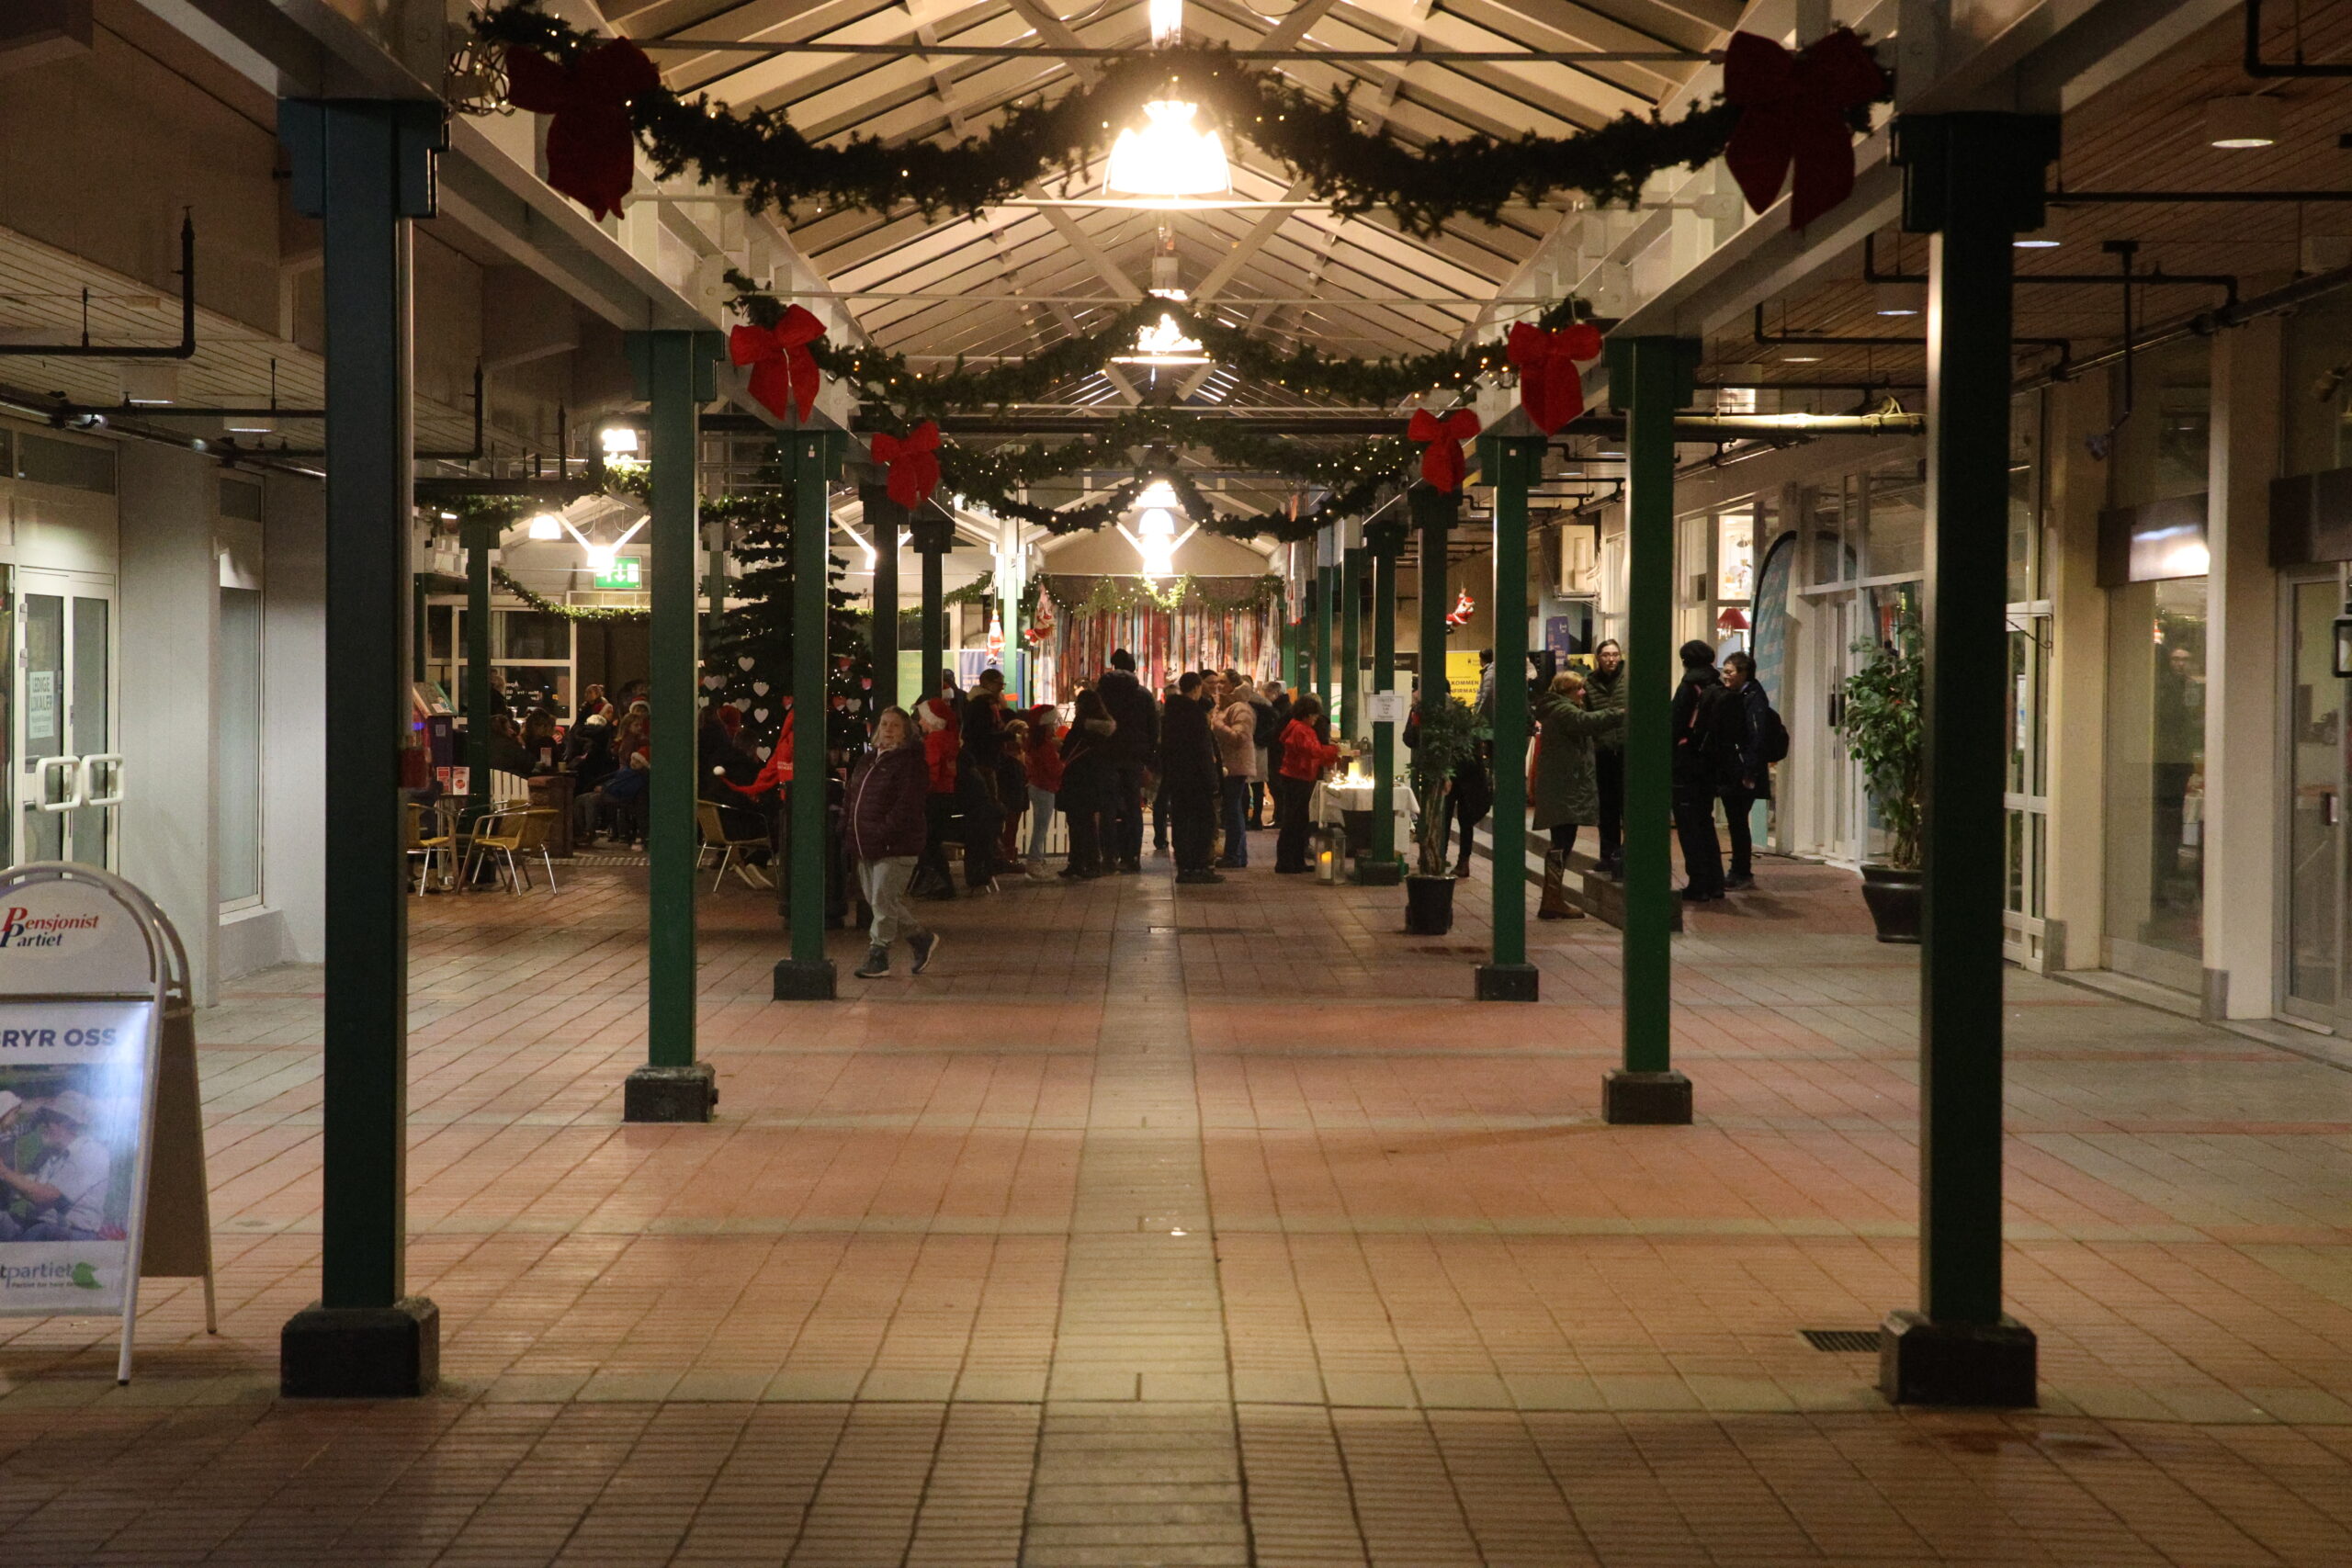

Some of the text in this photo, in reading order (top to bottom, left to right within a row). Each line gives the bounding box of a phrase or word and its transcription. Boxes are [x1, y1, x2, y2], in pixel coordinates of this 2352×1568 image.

[1, 907, 99, 932] Pensjonist
[0, 922, 62, 948] Partiet
[0, 1028, 117, 1047] RYR OSS
